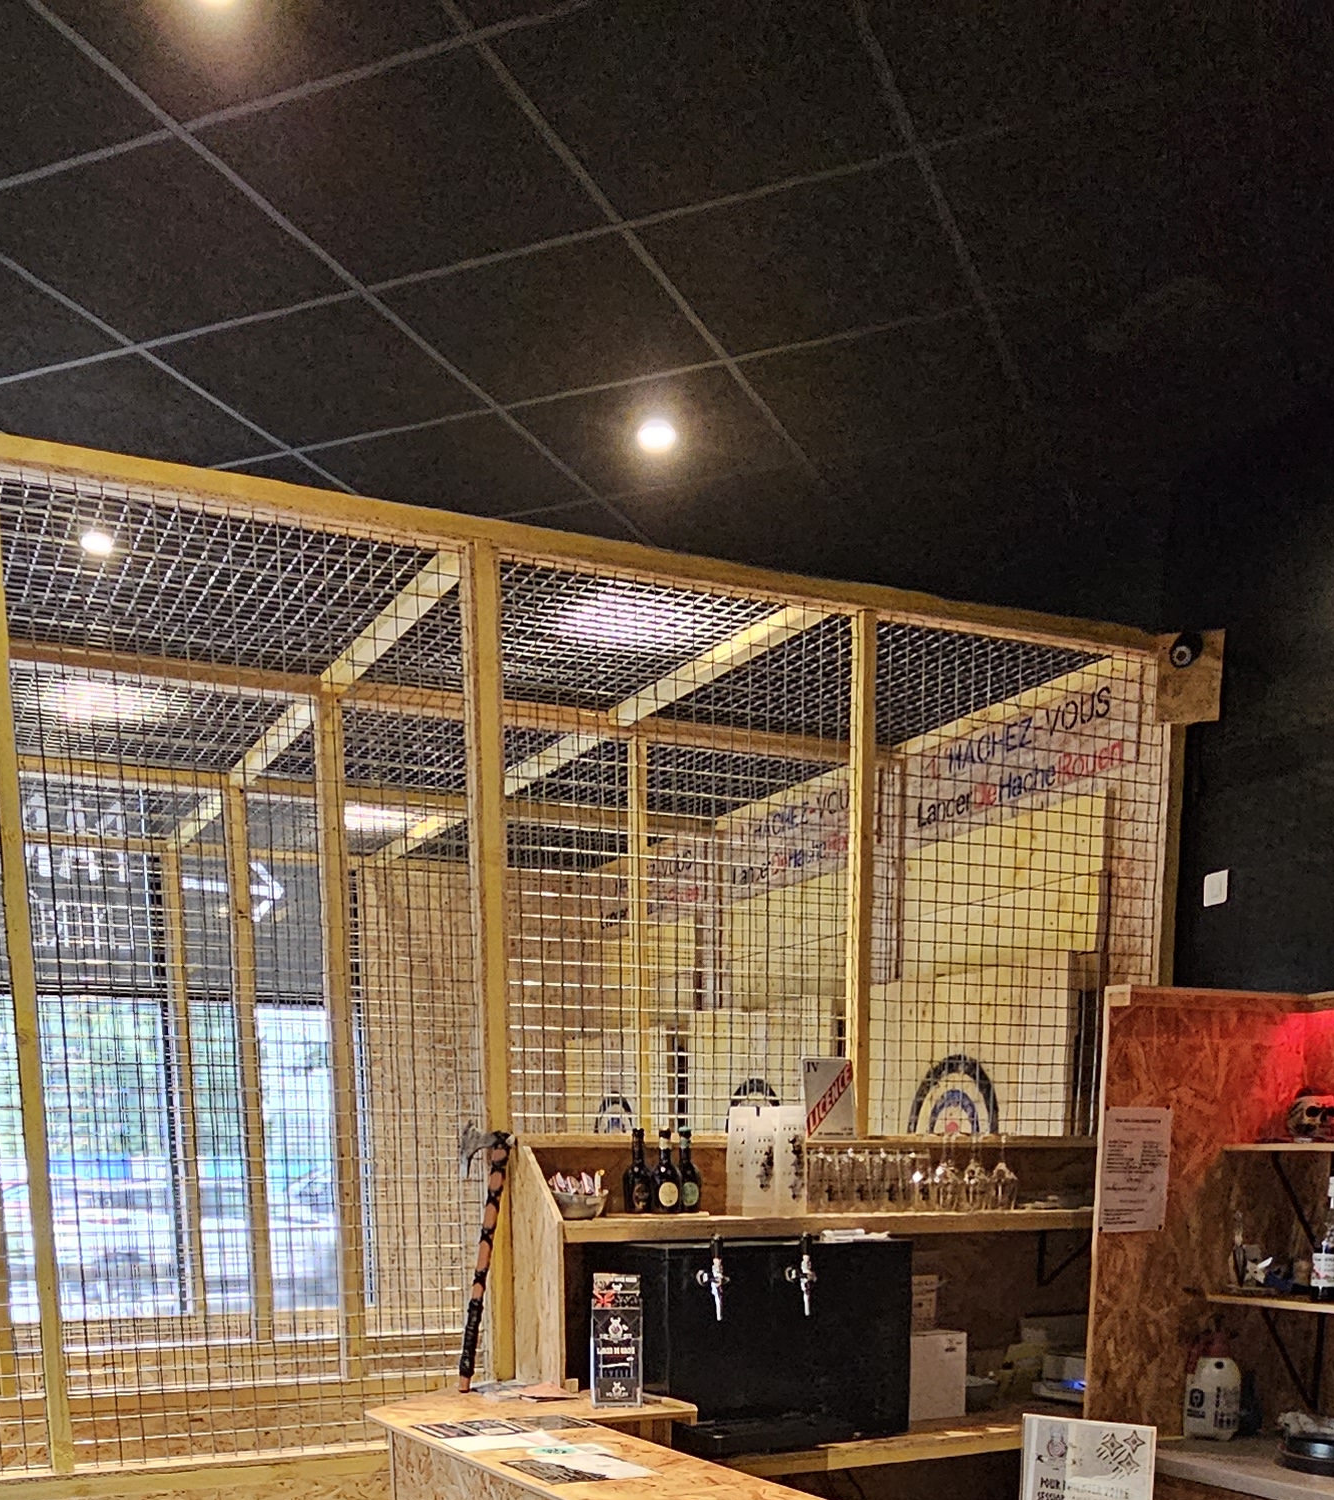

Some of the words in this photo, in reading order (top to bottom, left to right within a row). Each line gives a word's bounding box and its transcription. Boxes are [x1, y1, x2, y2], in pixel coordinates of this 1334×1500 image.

[806, 1061, 819, 1073] IV
[807, 1062, 852, 1136] LICENCE
[1040, 1477, 1061, 1490] POUR
